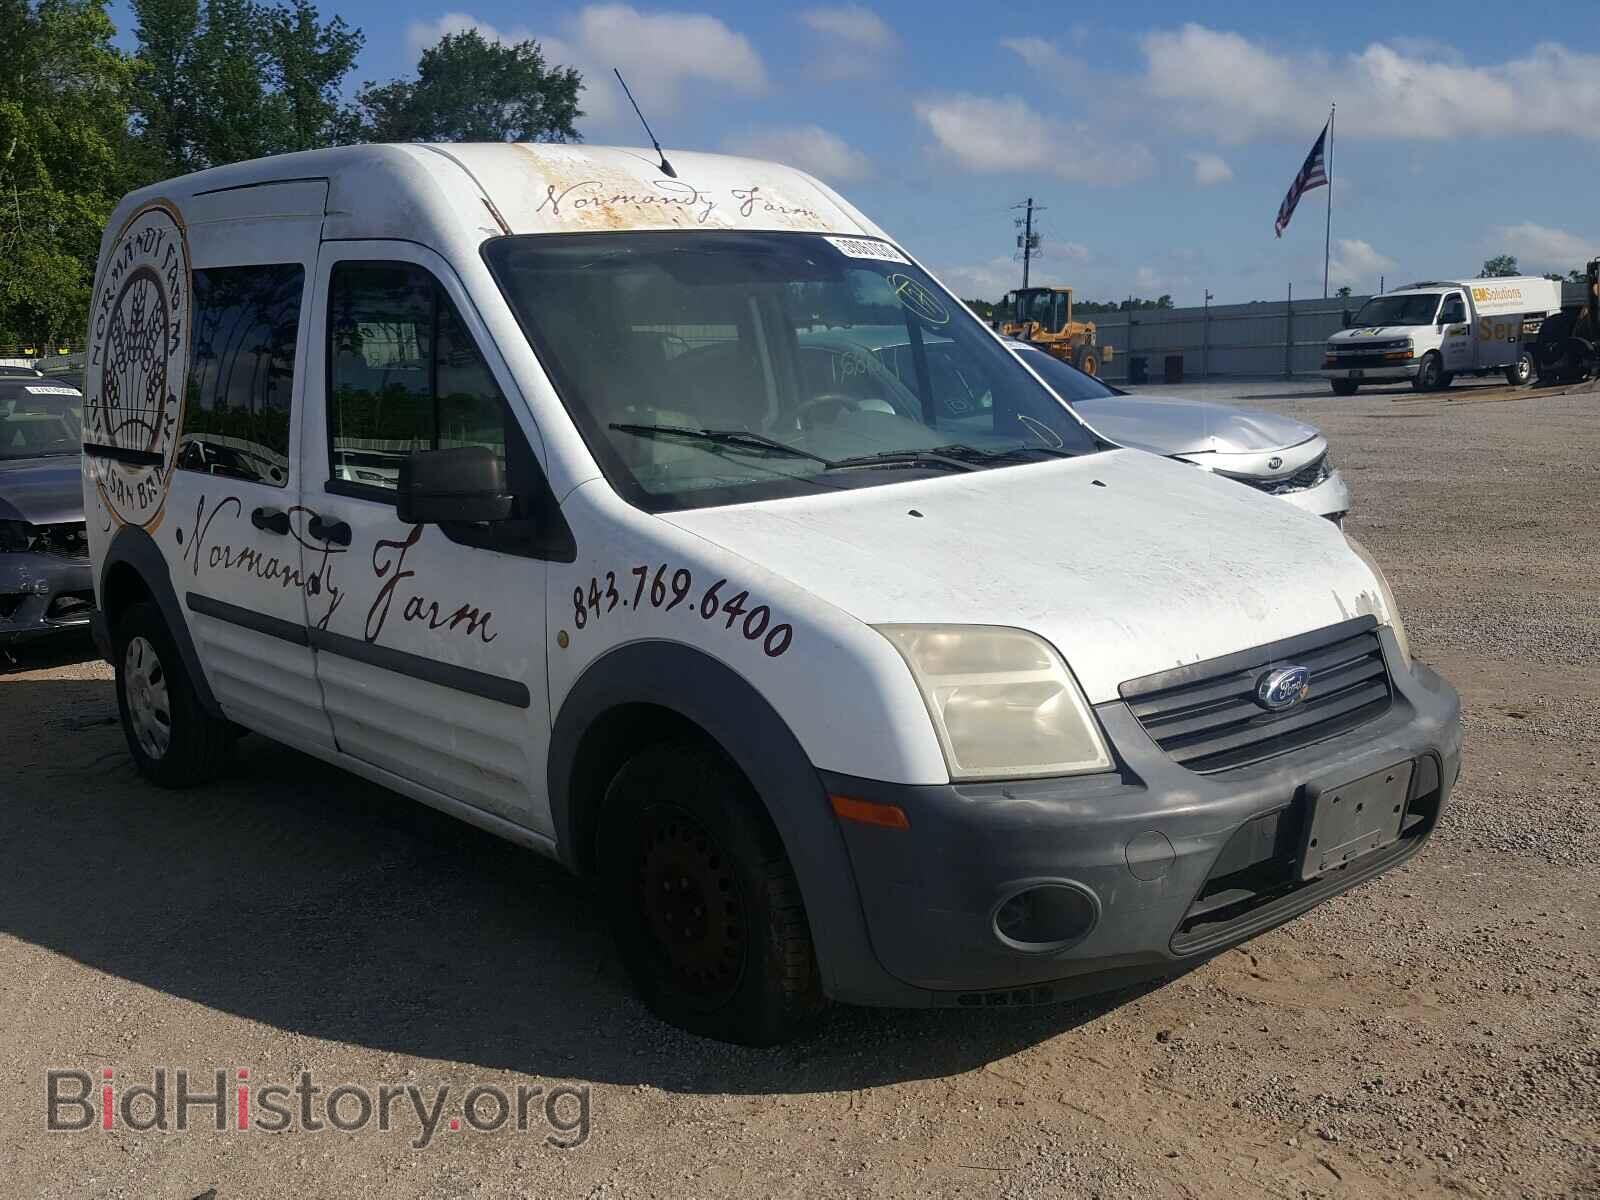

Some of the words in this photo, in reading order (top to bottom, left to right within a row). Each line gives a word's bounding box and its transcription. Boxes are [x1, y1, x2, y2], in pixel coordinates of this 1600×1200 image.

[536, 181, 718, 224] Normandy
[731, 187, 818, 217] Farm
[92, 227, 167, 366] NORMANDY
[184, 495, 347, 631] Normandy
[364, 522, 498, 643] Farm
[573, 563, 793, 658] 843.769.6400
